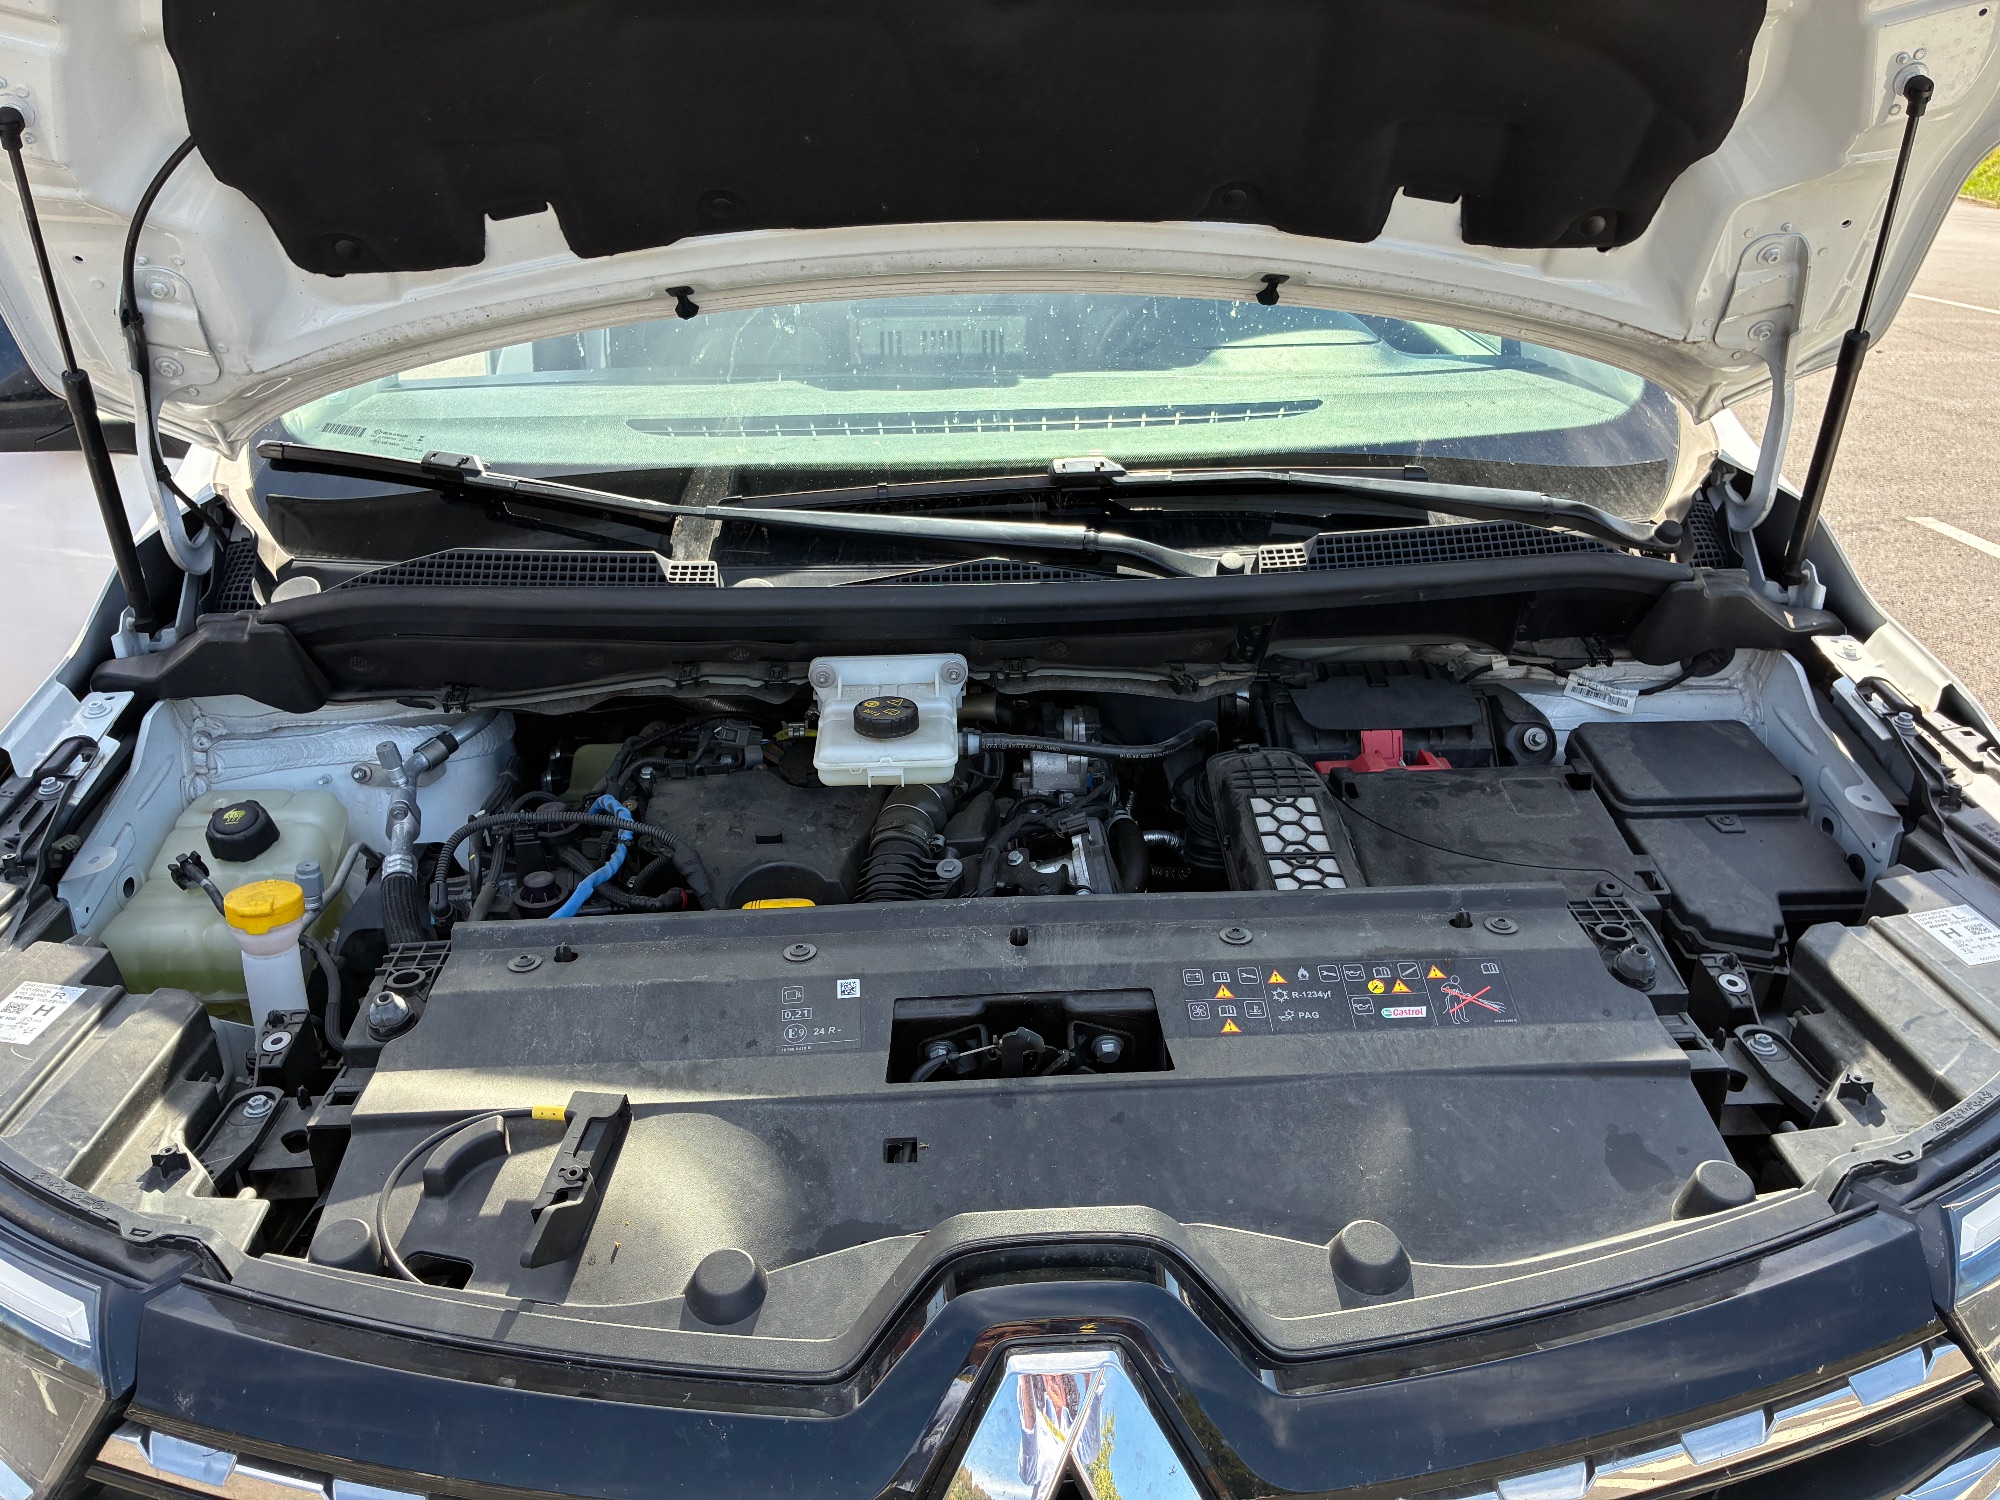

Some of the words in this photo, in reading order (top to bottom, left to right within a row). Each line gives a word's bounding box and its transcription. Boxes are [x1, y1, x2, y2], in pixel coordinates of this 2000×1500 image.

[1939, 927, 1963, 939] H
[51, 992, 67, 1000] R
[1291, 991, 1332, 999] R-1234yf
[32, 1004, 57, 1017] H
[784, 1010, 808, 1020] 0,21
[1298, 1011, 1320, 1019] PAG
[1392, 1008, 1424, 1017] Castrol
[788, 1028, 805, 1039] E9
[813, 1027, 825, 1036] 24
